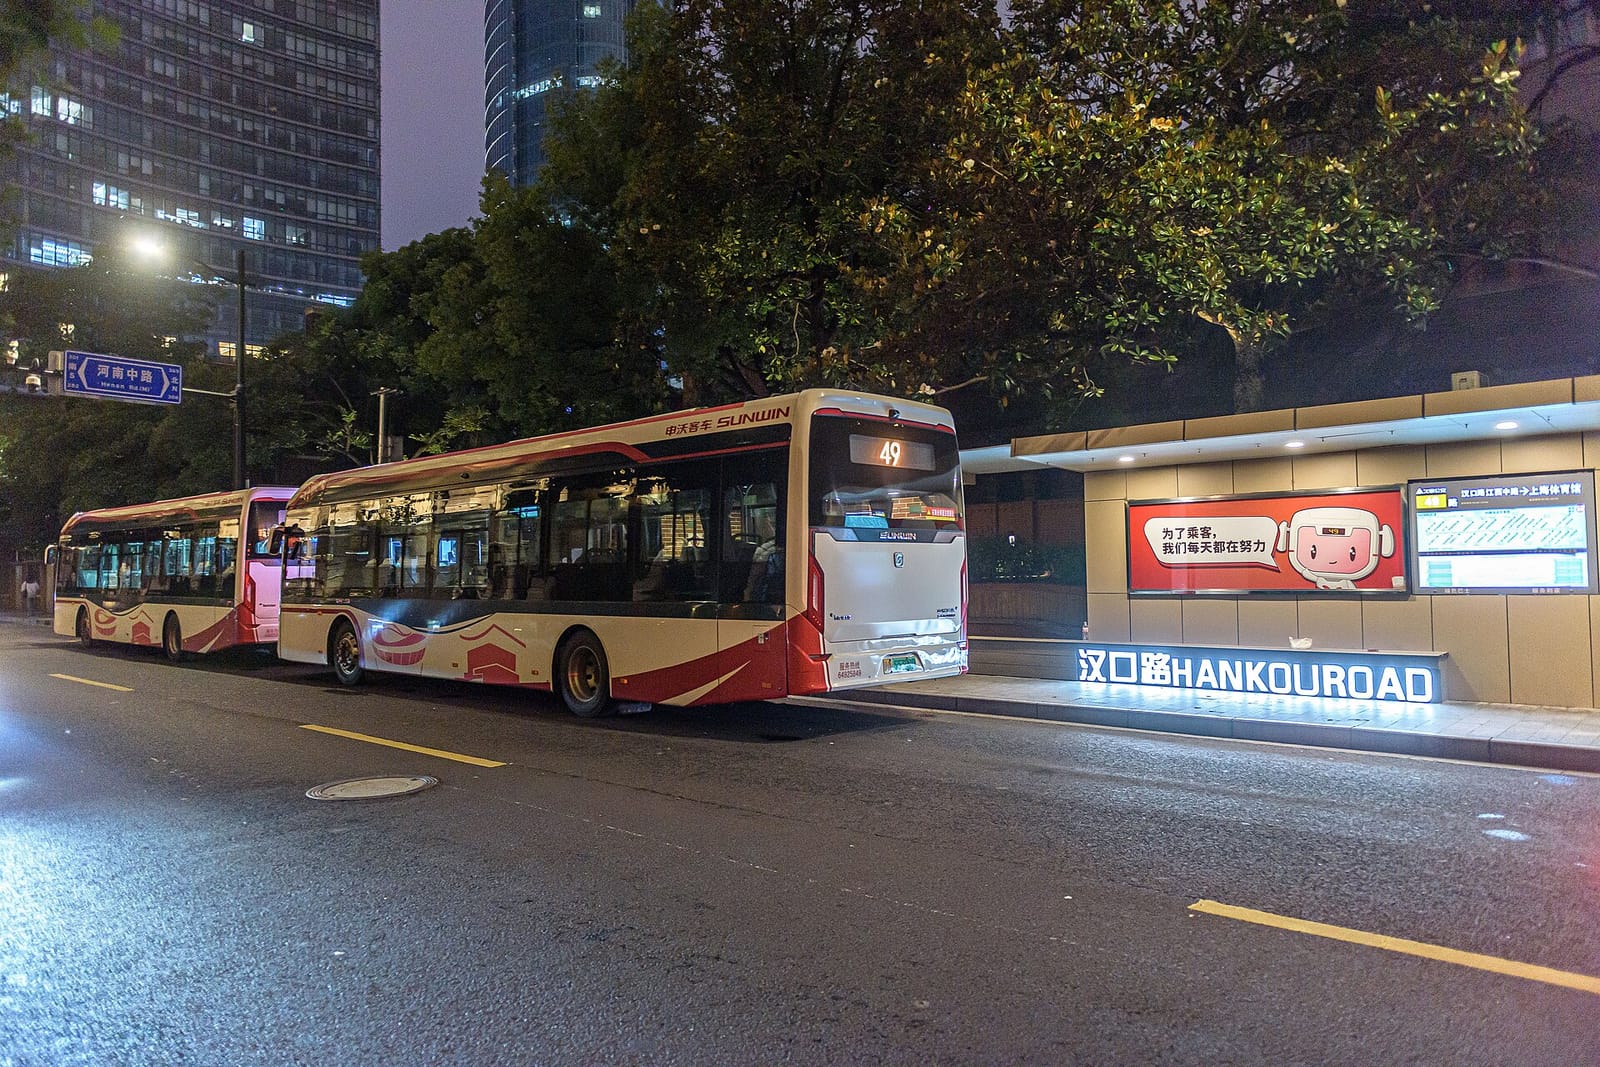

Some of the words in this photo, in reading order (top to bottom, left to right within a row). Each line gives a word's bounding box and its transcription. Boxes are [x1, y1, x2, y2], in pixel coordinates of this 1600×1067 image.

[97, 365, 153, 383] 河南中路
[171, 376, 179, 385] 北
[101, 381, 125, 390] Henan
[665, 420, 712, 436] 申沃客车
[717, 406, 790, 428] SUNWIN
[880, 441, 900, 467] 49
[1424, 496, 1440, 506] 49
[880, 531, 917, 541] SUNWIN
[1162, 525, 1217, 540] 为了乘客，
[1162, 540, 1266, 555] 我们每天都在努力
[1079, 649, 1171, 685] 汉口路
